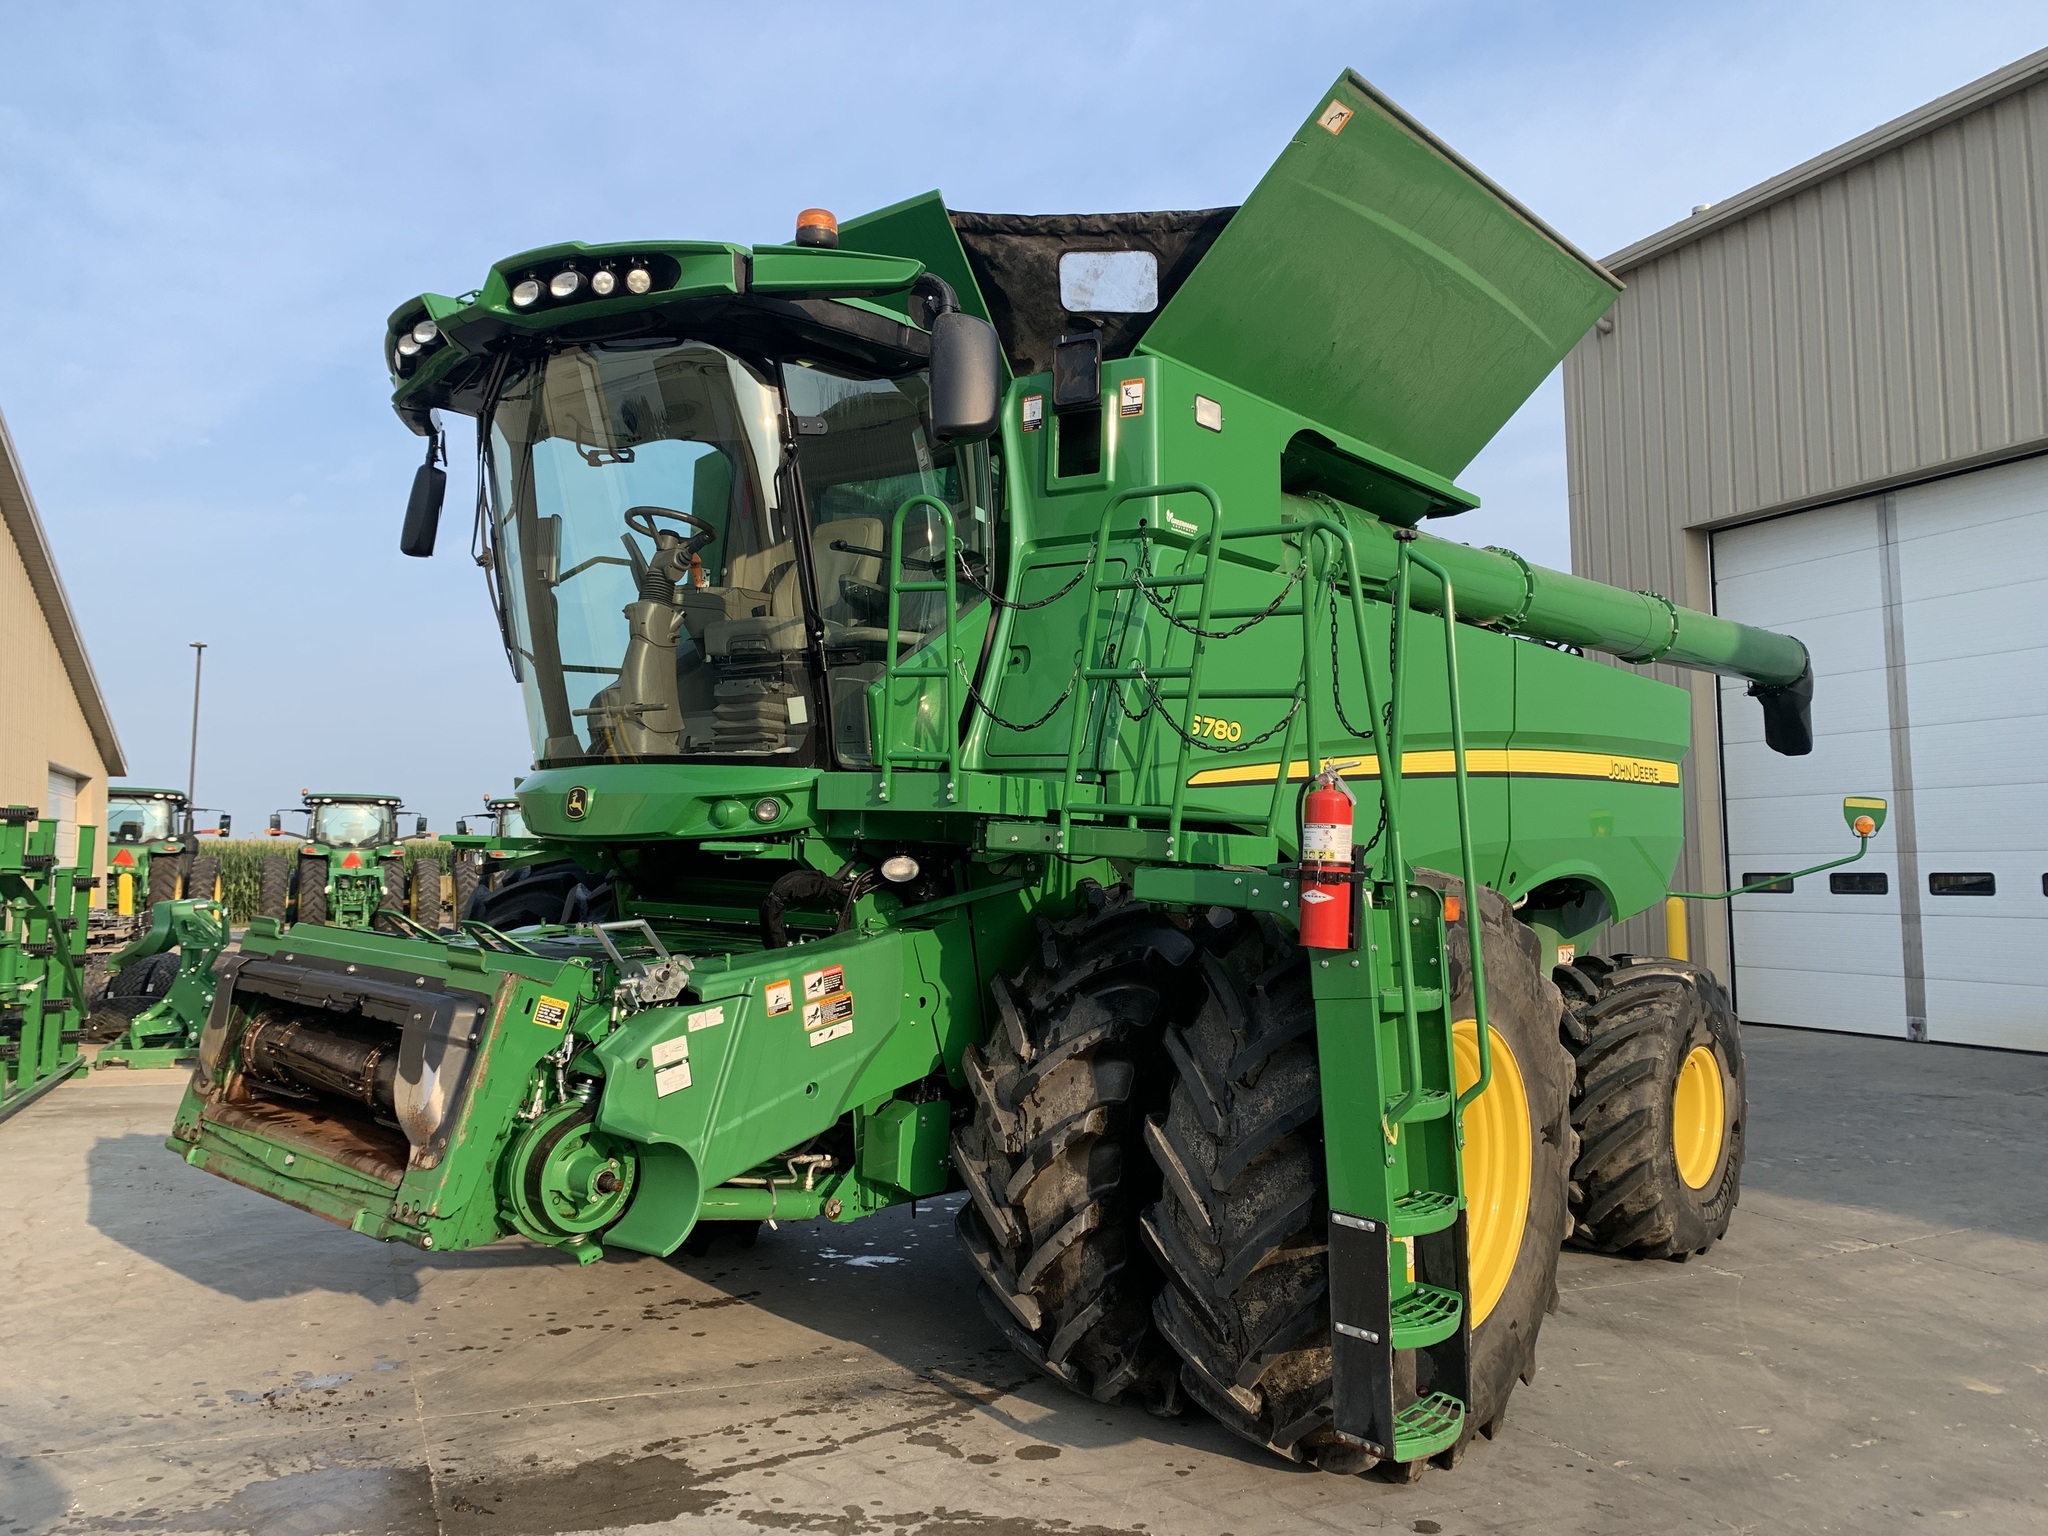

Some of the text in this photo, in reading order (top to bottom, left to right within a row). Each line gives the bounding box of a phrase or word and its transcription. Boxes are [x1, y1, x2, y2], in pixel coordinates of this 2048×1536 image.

[1608, 759, 1660, 781] JOHN DEERE
[545, 997, 568, 1008] CAUTION
